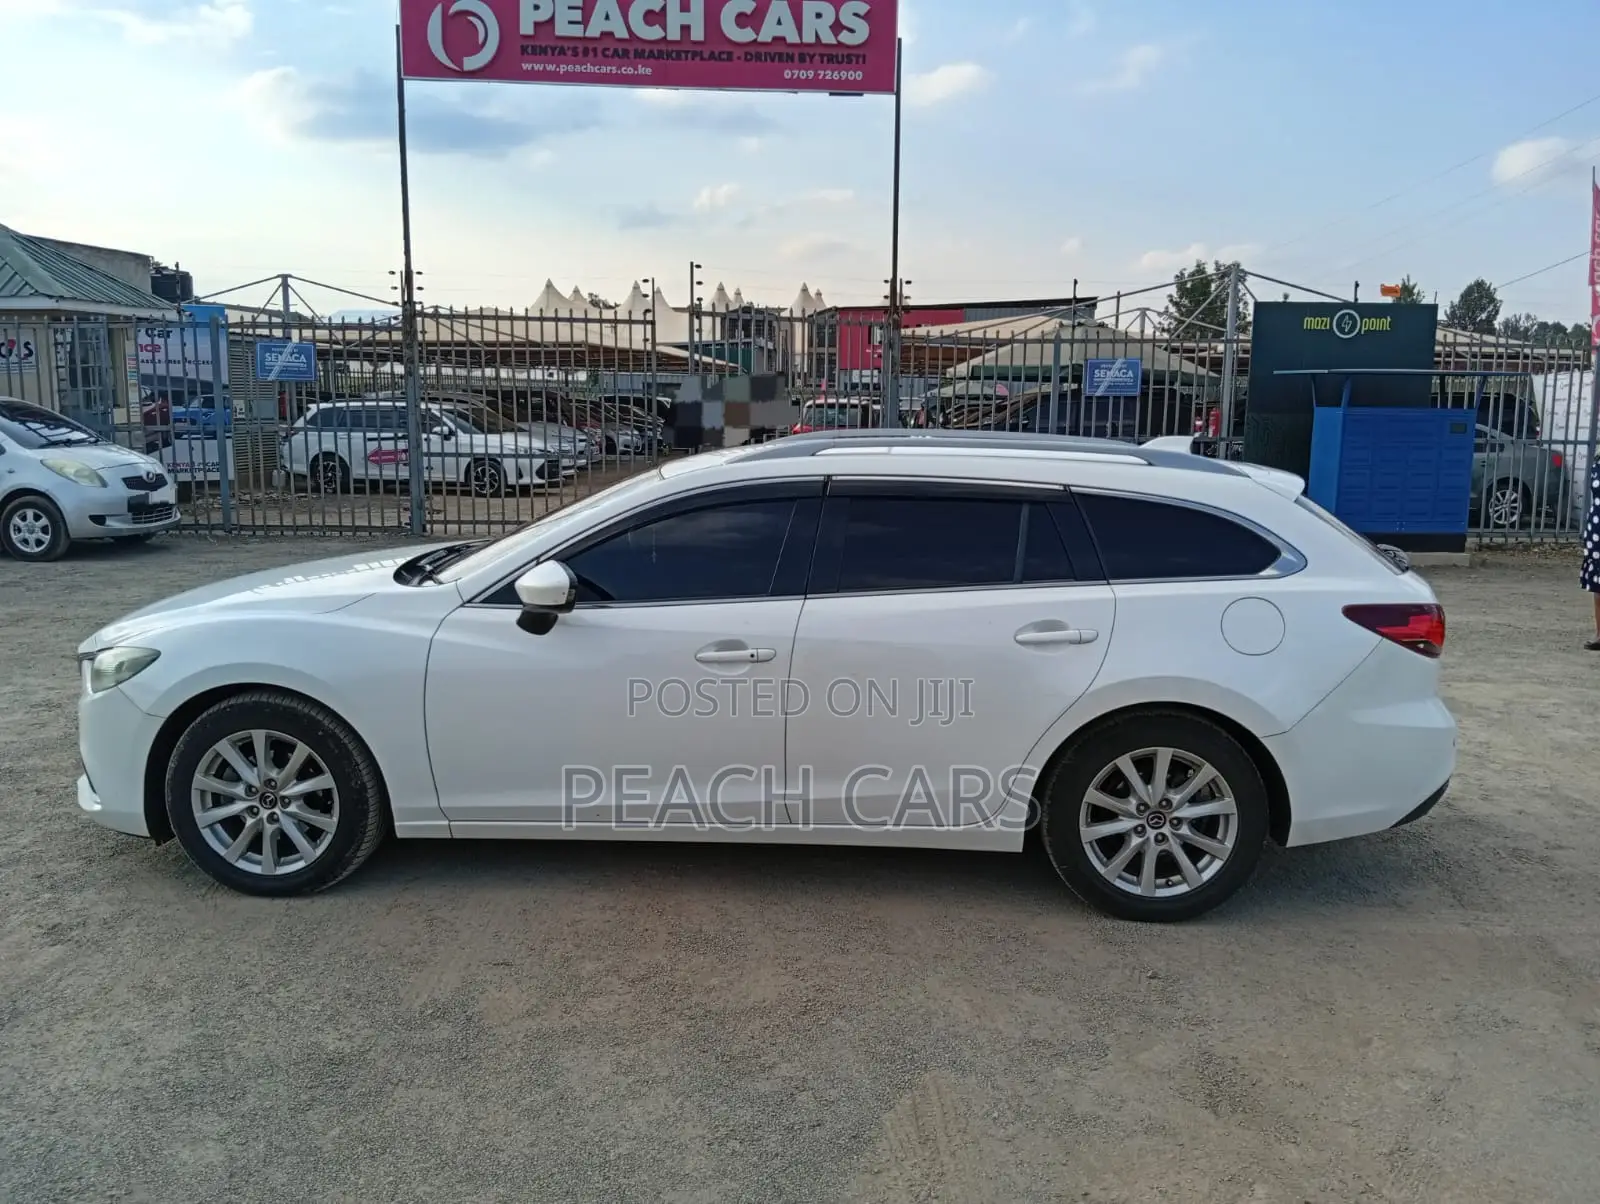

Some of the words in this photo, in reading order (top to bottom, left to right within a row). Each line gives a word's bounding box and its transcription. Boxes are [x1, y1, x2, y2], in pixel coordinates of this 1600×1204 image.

[519, 0, 705, 42] PEACH
[720, 0, 872, 46] CARS
[520, 44, 579, 58] KENYA'S
[602, 47, 631, 60] CAR
[633, 49, 734, 63] MARKETPLACE
[743, 52, 795, 64] DRIVEN
[797, 53, 817, 65] BY
[521, 61, 653, 76] www.peachcars.co.ke
[783, 69, 815, 80] 0709
[817, 70, 863, 81] 726900
[1361, 316, 1391, 335] point
